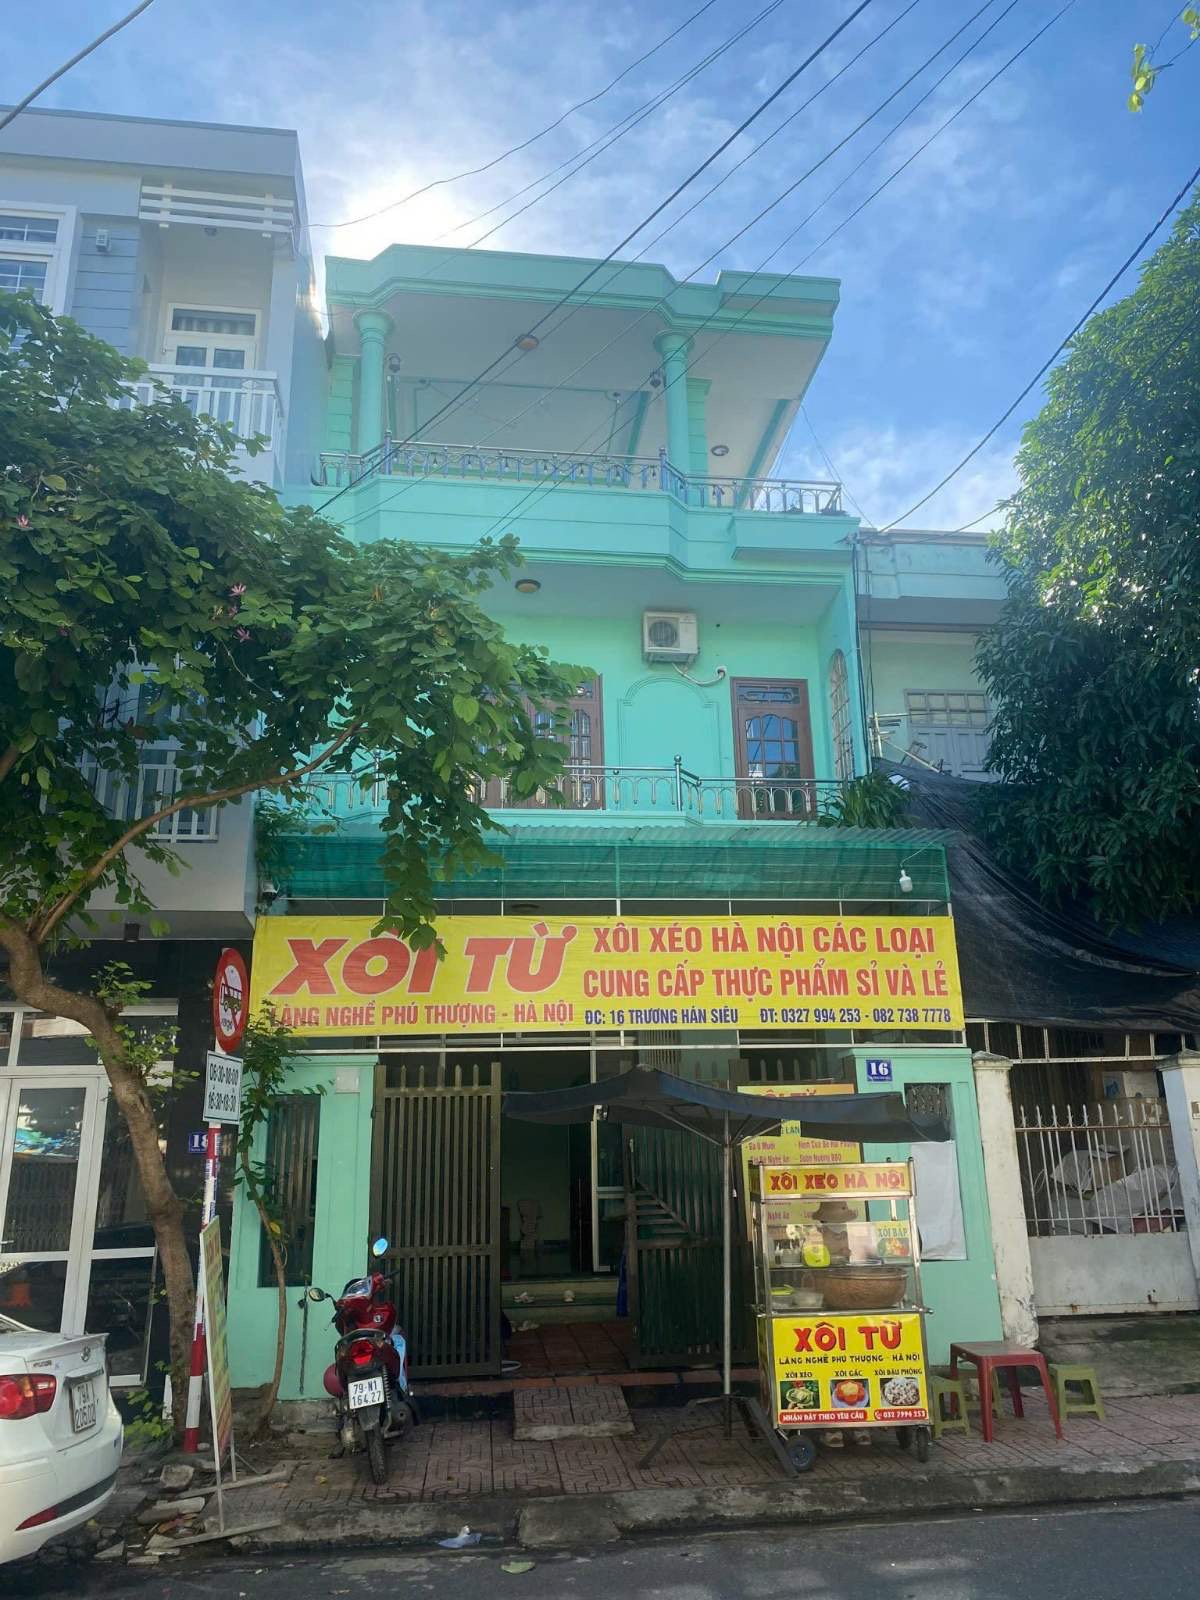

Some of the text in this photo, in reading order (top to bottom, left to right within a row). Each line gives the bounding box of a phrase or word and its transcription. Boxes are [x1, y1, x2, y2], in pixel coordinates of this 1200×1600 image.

[592, 921, 935, 959] XÔI XÉO HÀ NỘI CÁC LOẠI
[269, 921, 578, 996] XÔI TỪ
[583, 958, 949, 1002] CUNG CẤP THỰC PHẨM SỈ VÀ LẺ
[270, 1003, 320, 1027] LÀNG
[326, 1000, 376, 1026] NGHỀ
[381, 1002, 419, 1025] PHÚ
[425, 1004, 496, 1028] THƯỢNG
[513, 1002, 537, 1024] HÀ
[543, 1000, 575, 1030] NỘI
[585, 1009, 606, 1025] ĐC:
[609, 1009, 625, 1025] 16
[682, 1005, 707, 1024] HÁN
[711, 1005, 739, 1023] SIÊU
[760, 1008, 778, 1023] ĐT:
[781, 1008, 810, 1023] 0327
[814, 1008, 836, 1023] 994
[839, 1008, 861, 1023] 253
[873, 1008, 895, 1023] 082
[898, 1008, 920, 1023] 738
[922, 1008, 951, 1023] 7778
[869, 1062, 889, 1076] 16
[192, 1134, 208, 1149] 18
[770, 1172, 797, 1191] XÔI
[844, 1170, 868, 1188] HÀ
[875, 1170, 905, 1189] NỘI
[793, 1320, 903, 1352] XÔI TỪ
